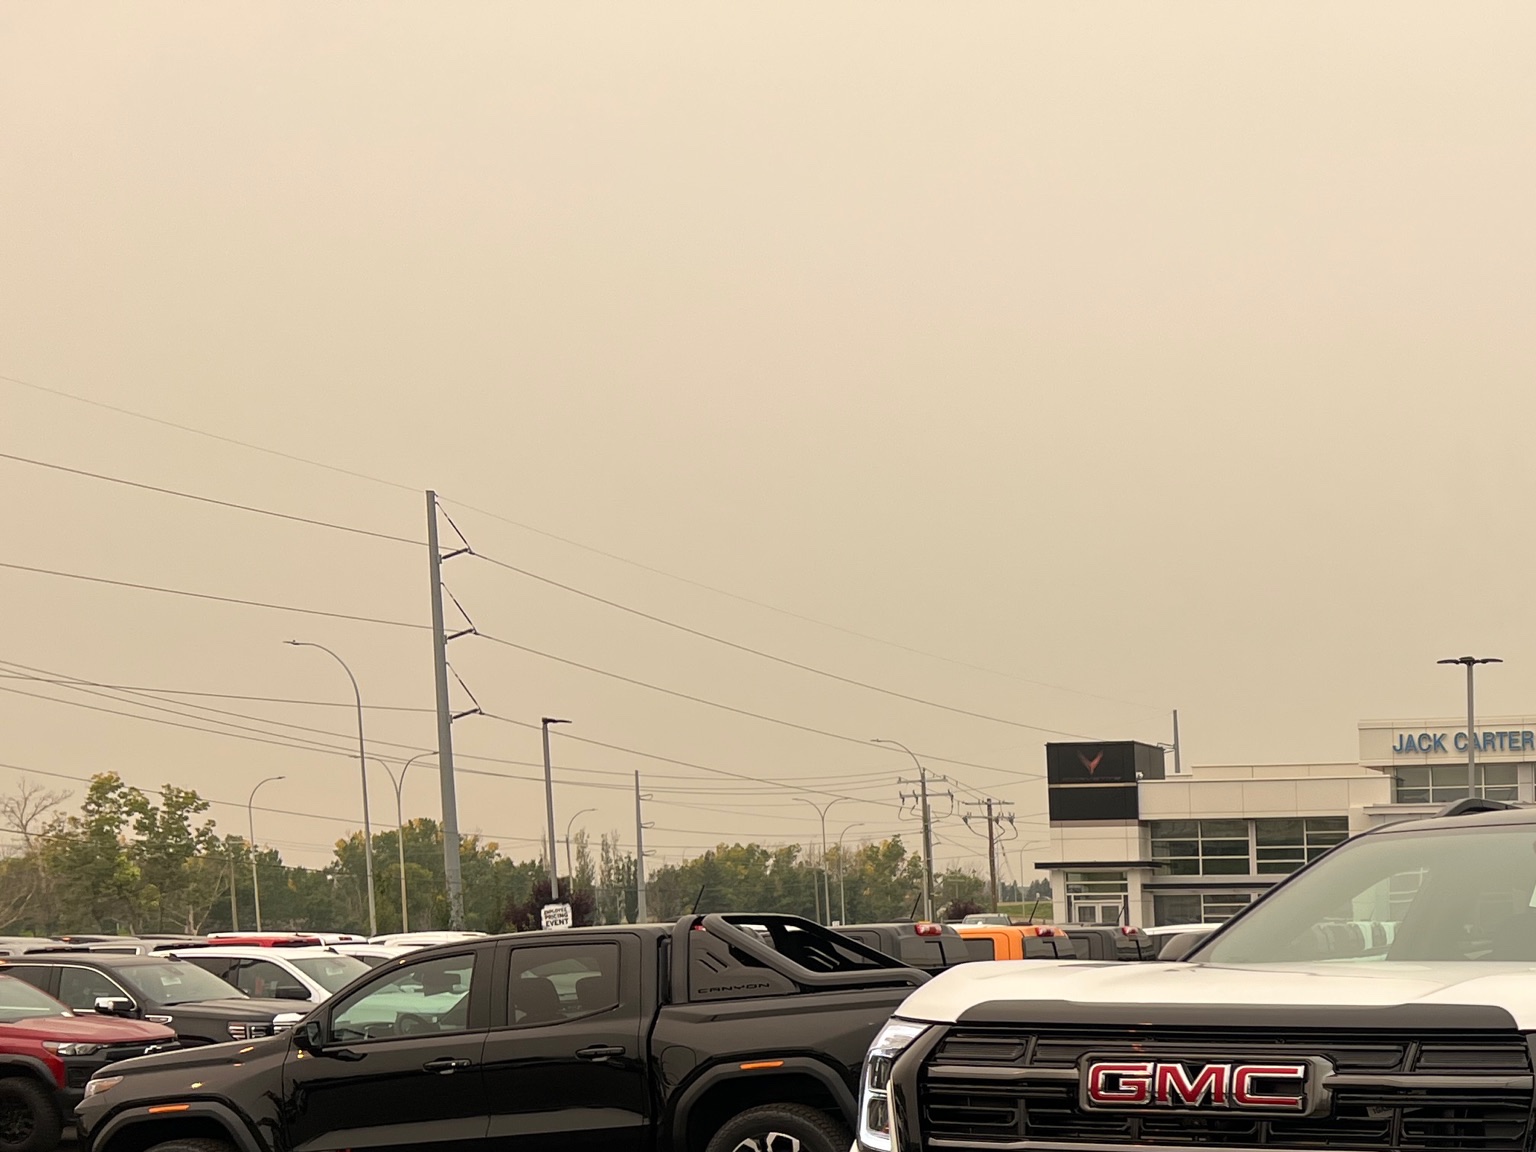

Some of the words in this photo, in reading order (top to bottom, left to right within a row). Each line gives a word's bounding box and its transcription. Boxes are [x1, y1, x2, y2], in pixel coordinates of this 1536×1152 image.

[1392, 733, 1448, 753] JACK
[1454, 731, 1535, 752] CARTER
[545, 918, 569, 927] EVENT
[697, 982, 770, 994] CANYON
[1087, 1061, 1306, 1110] GMC
